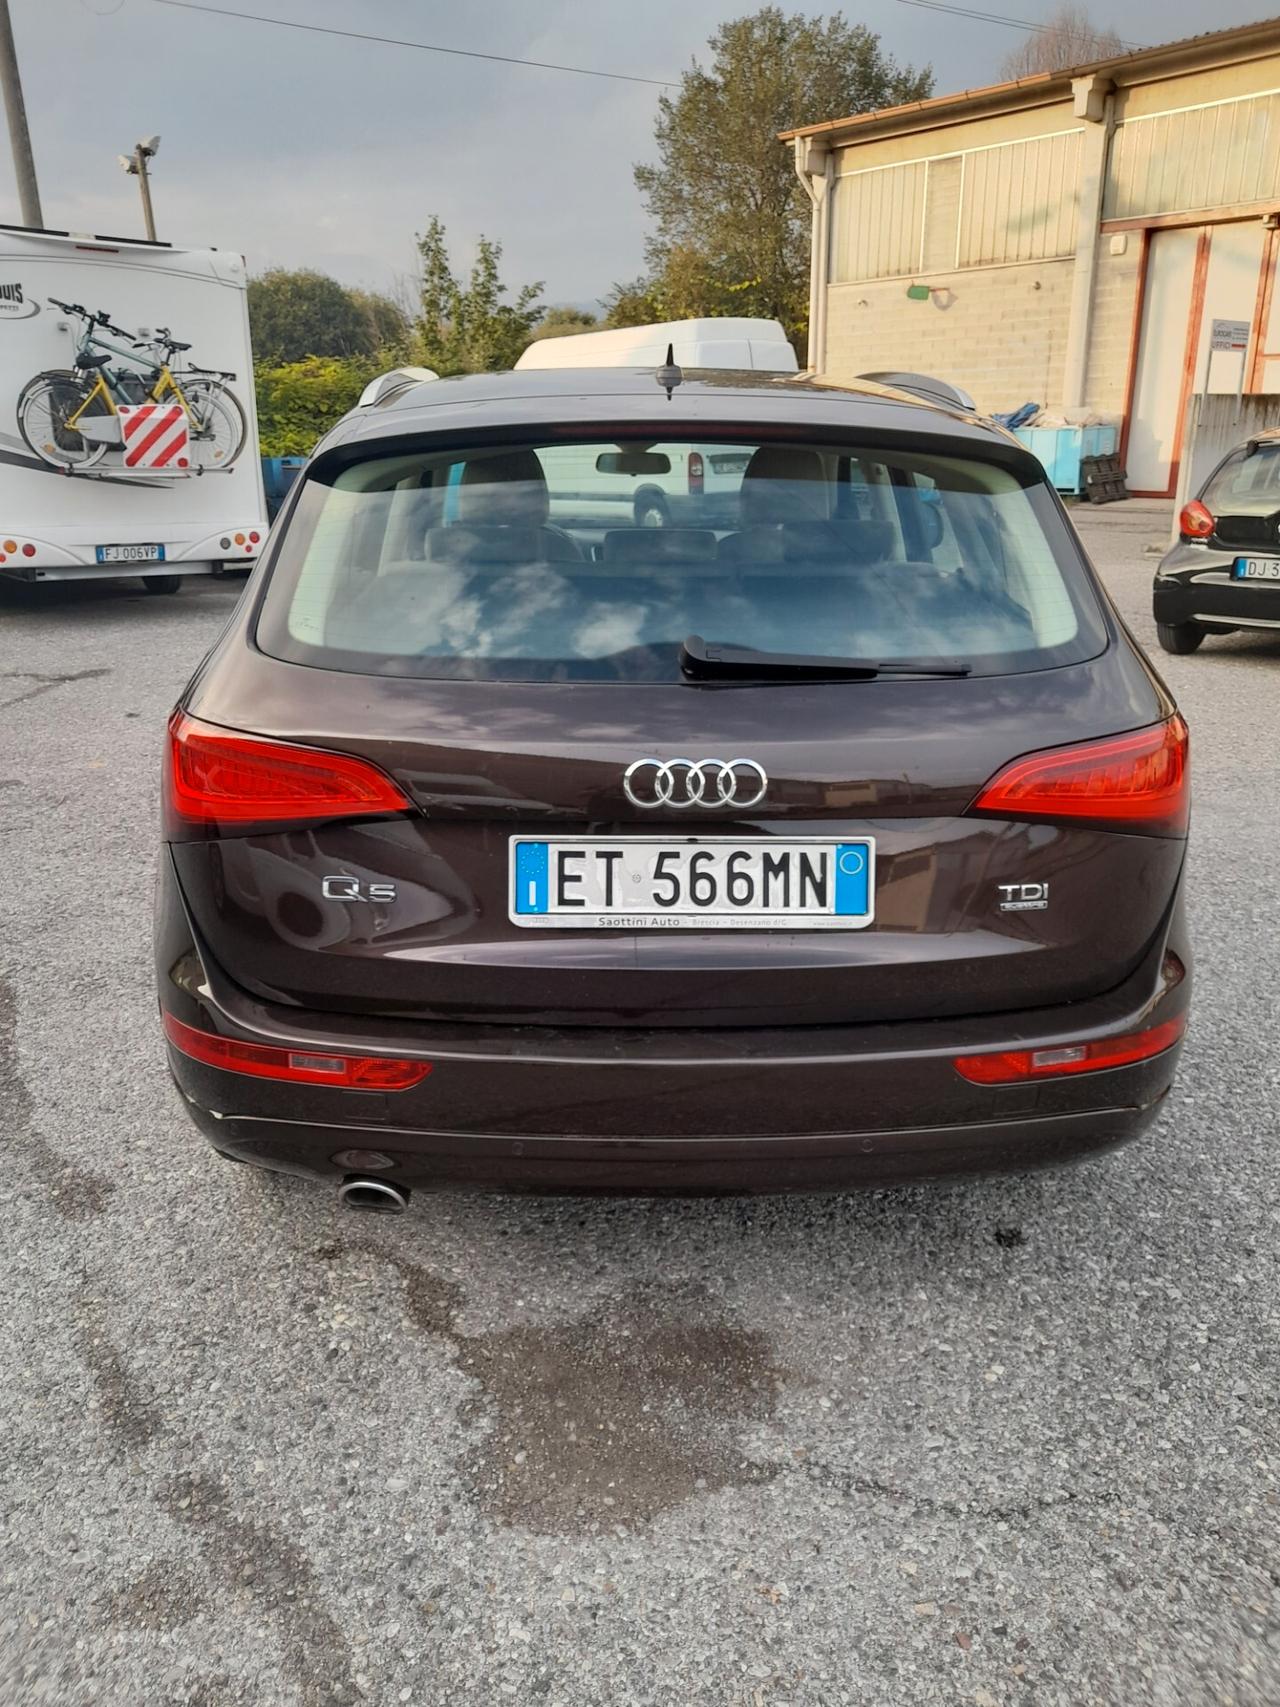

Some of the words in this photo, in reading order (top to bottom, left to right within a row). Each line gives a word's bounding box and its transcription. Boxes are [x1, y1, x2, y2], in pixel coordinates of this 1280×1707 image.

[0, 283, 23, 304] UIS
[105, 548, 120, 559] FJ
[123, 547, 157, 559] 006VP
[1248, 561, 1267, 576] DJ
[1271, 562, 1280, 577] 3
[557, 850, 624, 907] ET
[653, 851, 828, 908] 566MN
[322, 875, 397, 903] Q5
[998, 883, 1049, 901] TDI
[599, 917, 647, 926] Saottini
[652, 917, 680, 926] Auto
